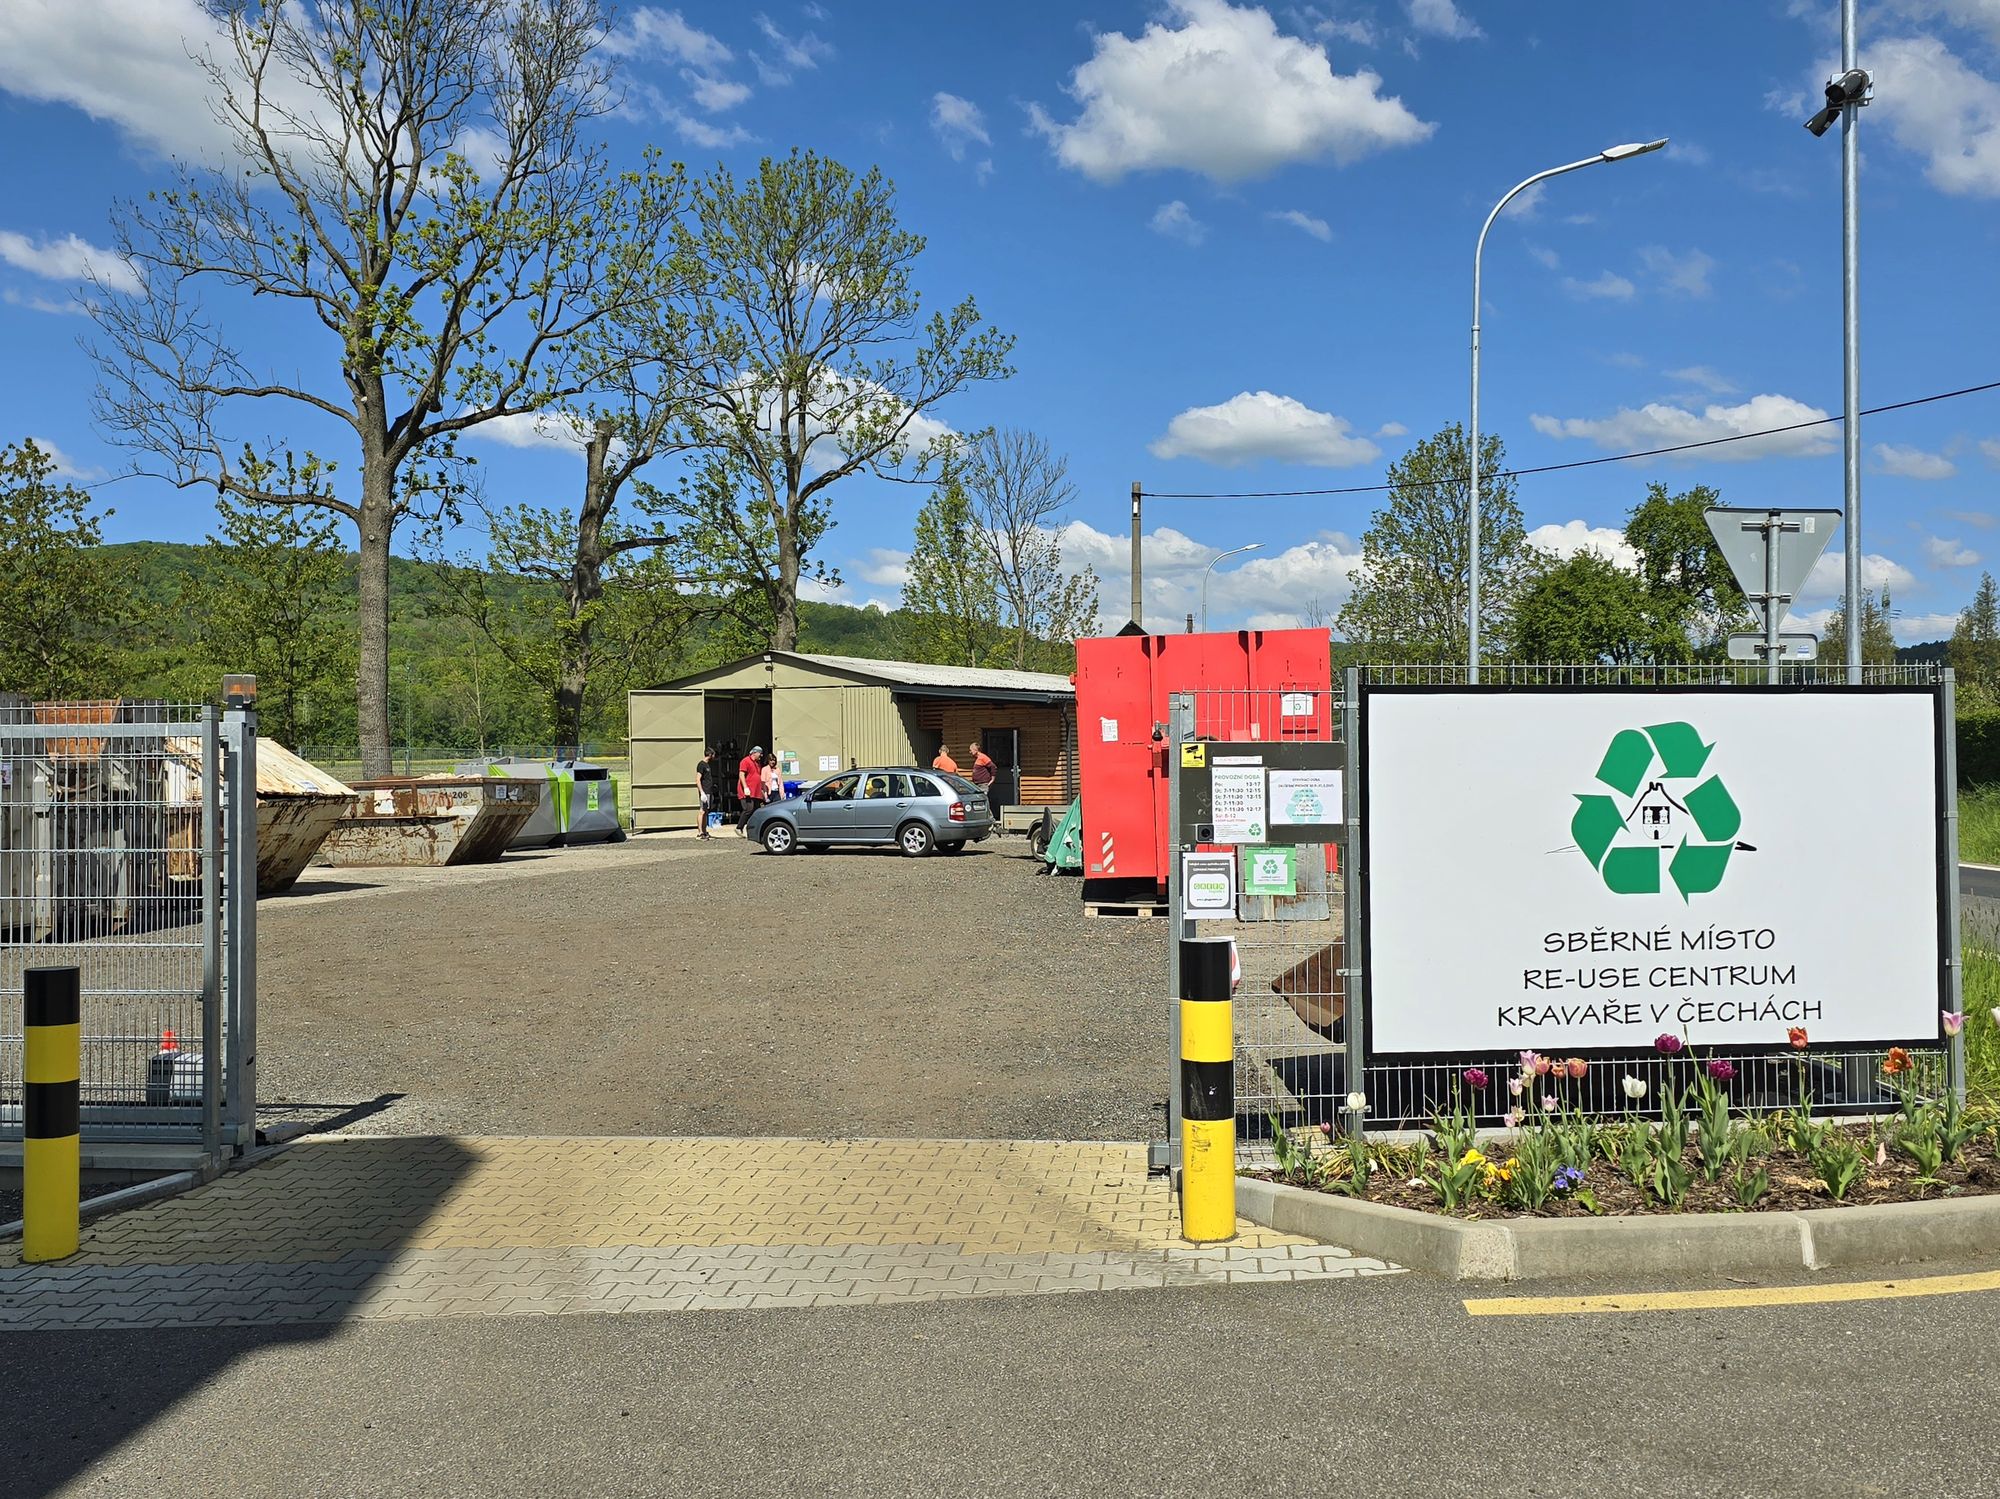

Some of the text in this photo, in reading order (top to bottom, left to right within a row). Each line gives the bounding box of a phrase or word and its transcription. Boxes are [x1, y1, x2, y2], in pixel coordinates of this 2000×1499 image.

[1543, 923, 1776, 953] SBĚRNÉ MÍSTO
[1523, 964, 1797, 990] RE-USE CENTRUM
[1498, 993, 1823, 1027] KRAVAŘE V ČECHÁCH
